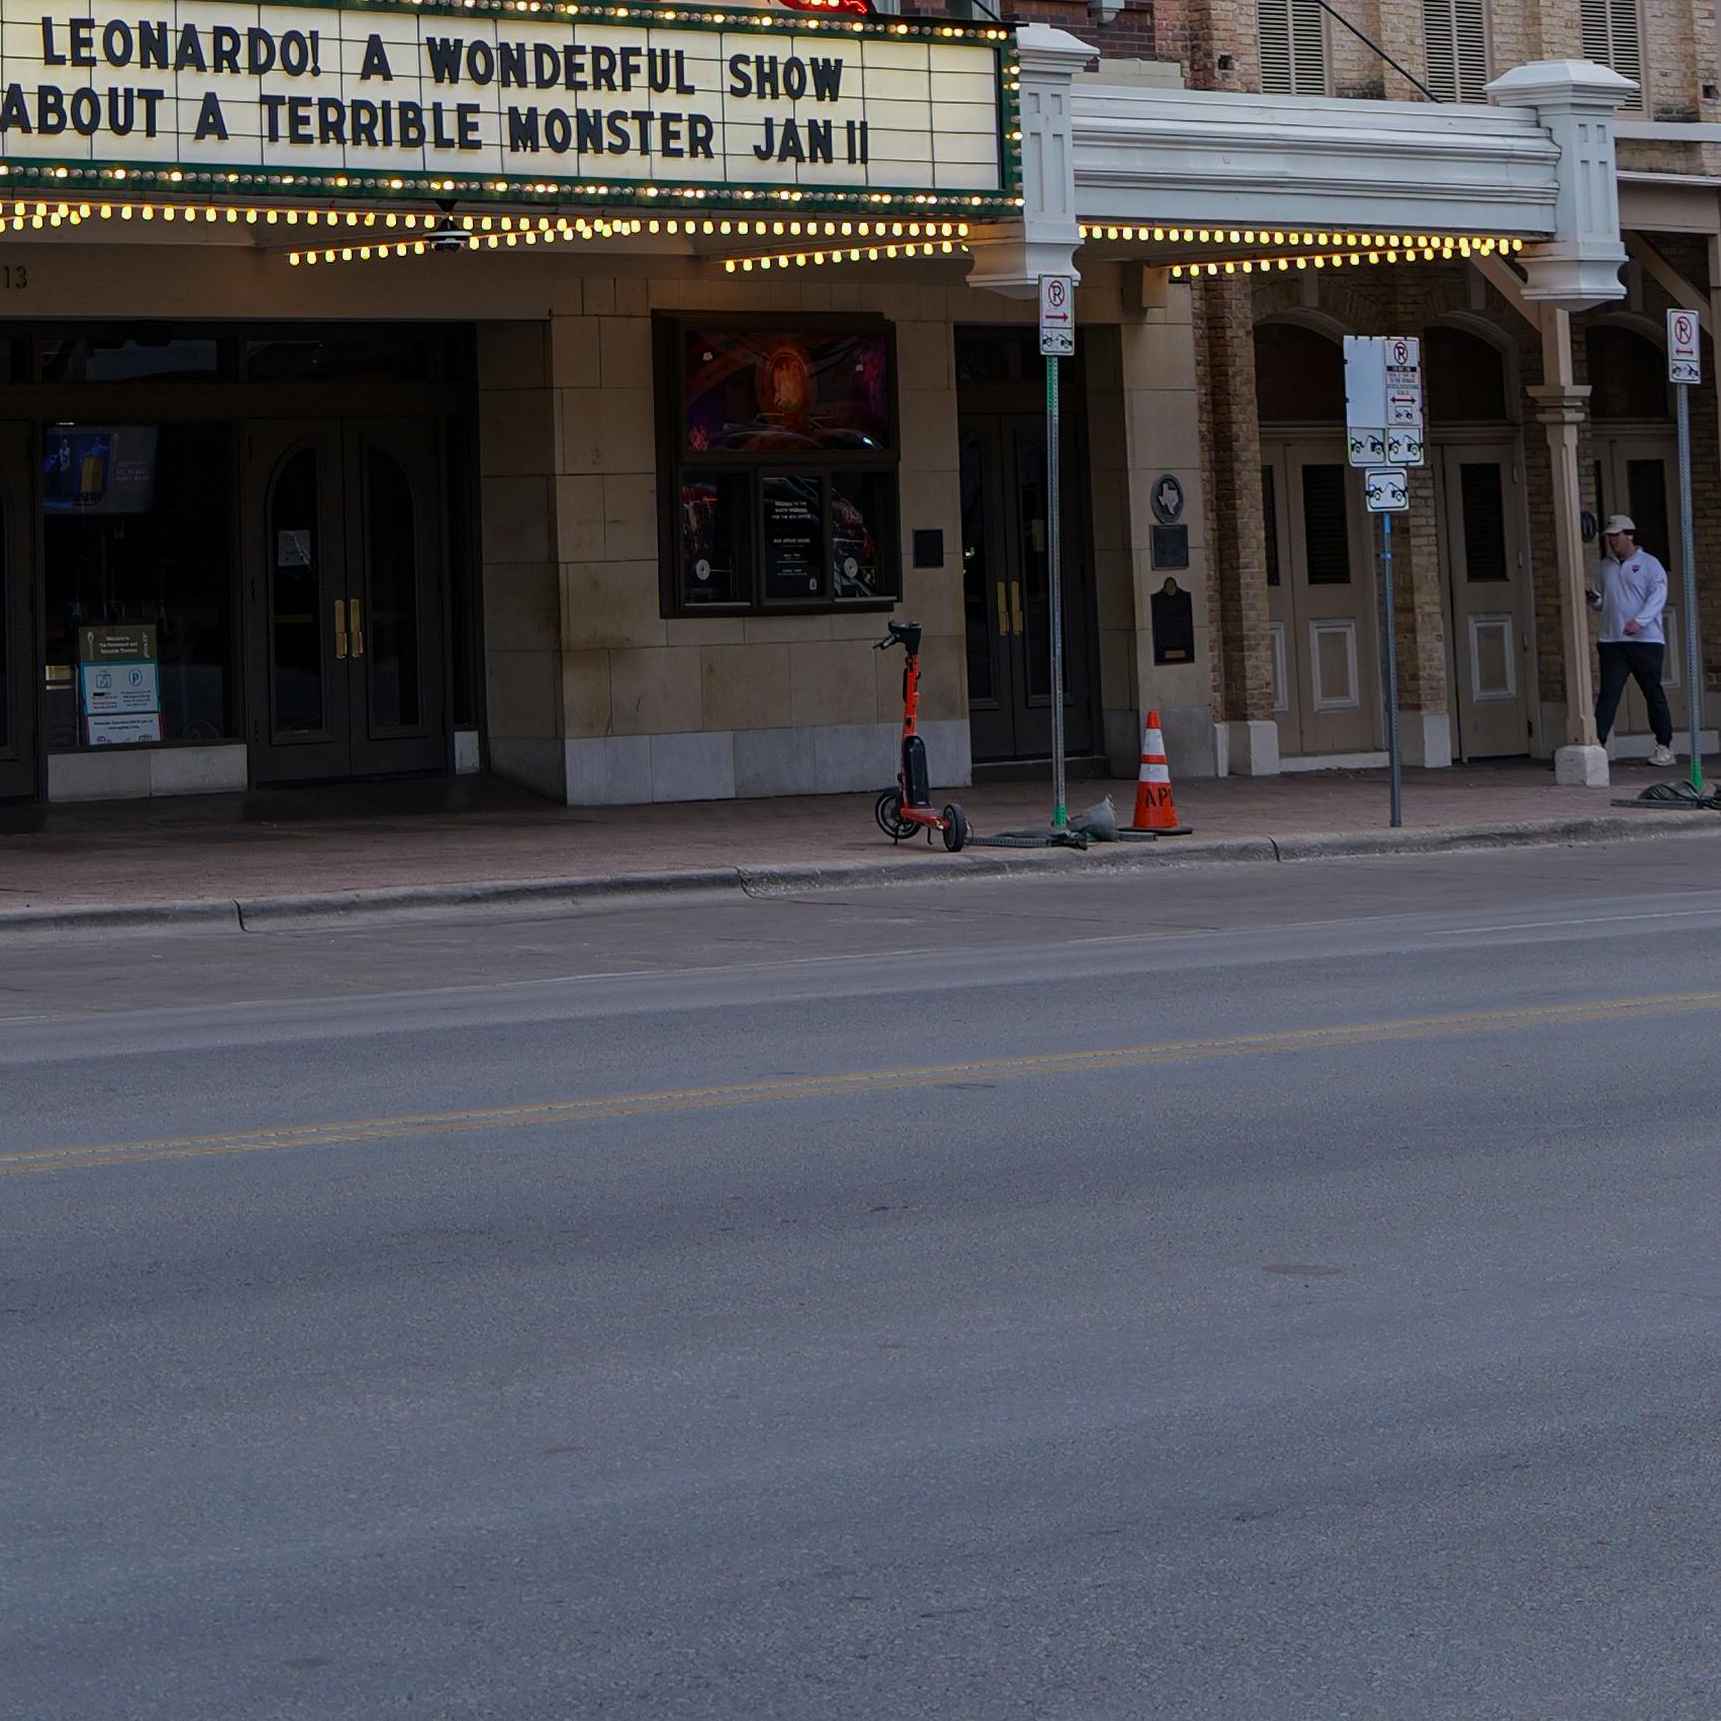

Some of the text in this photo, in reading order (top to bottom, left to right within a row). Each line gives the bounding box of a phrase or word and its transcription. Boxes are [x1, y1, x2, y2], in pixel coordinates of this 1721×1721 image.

[41, 16, 844, 102] LEONARDO! A WONDERFUL SHOW
[193, 91, 229, 141] A
[259, 94, 482, 150] TERRIBLE
[508, 105, 715, 159] MONSTER
[753, 116, 833, 164] JAN
